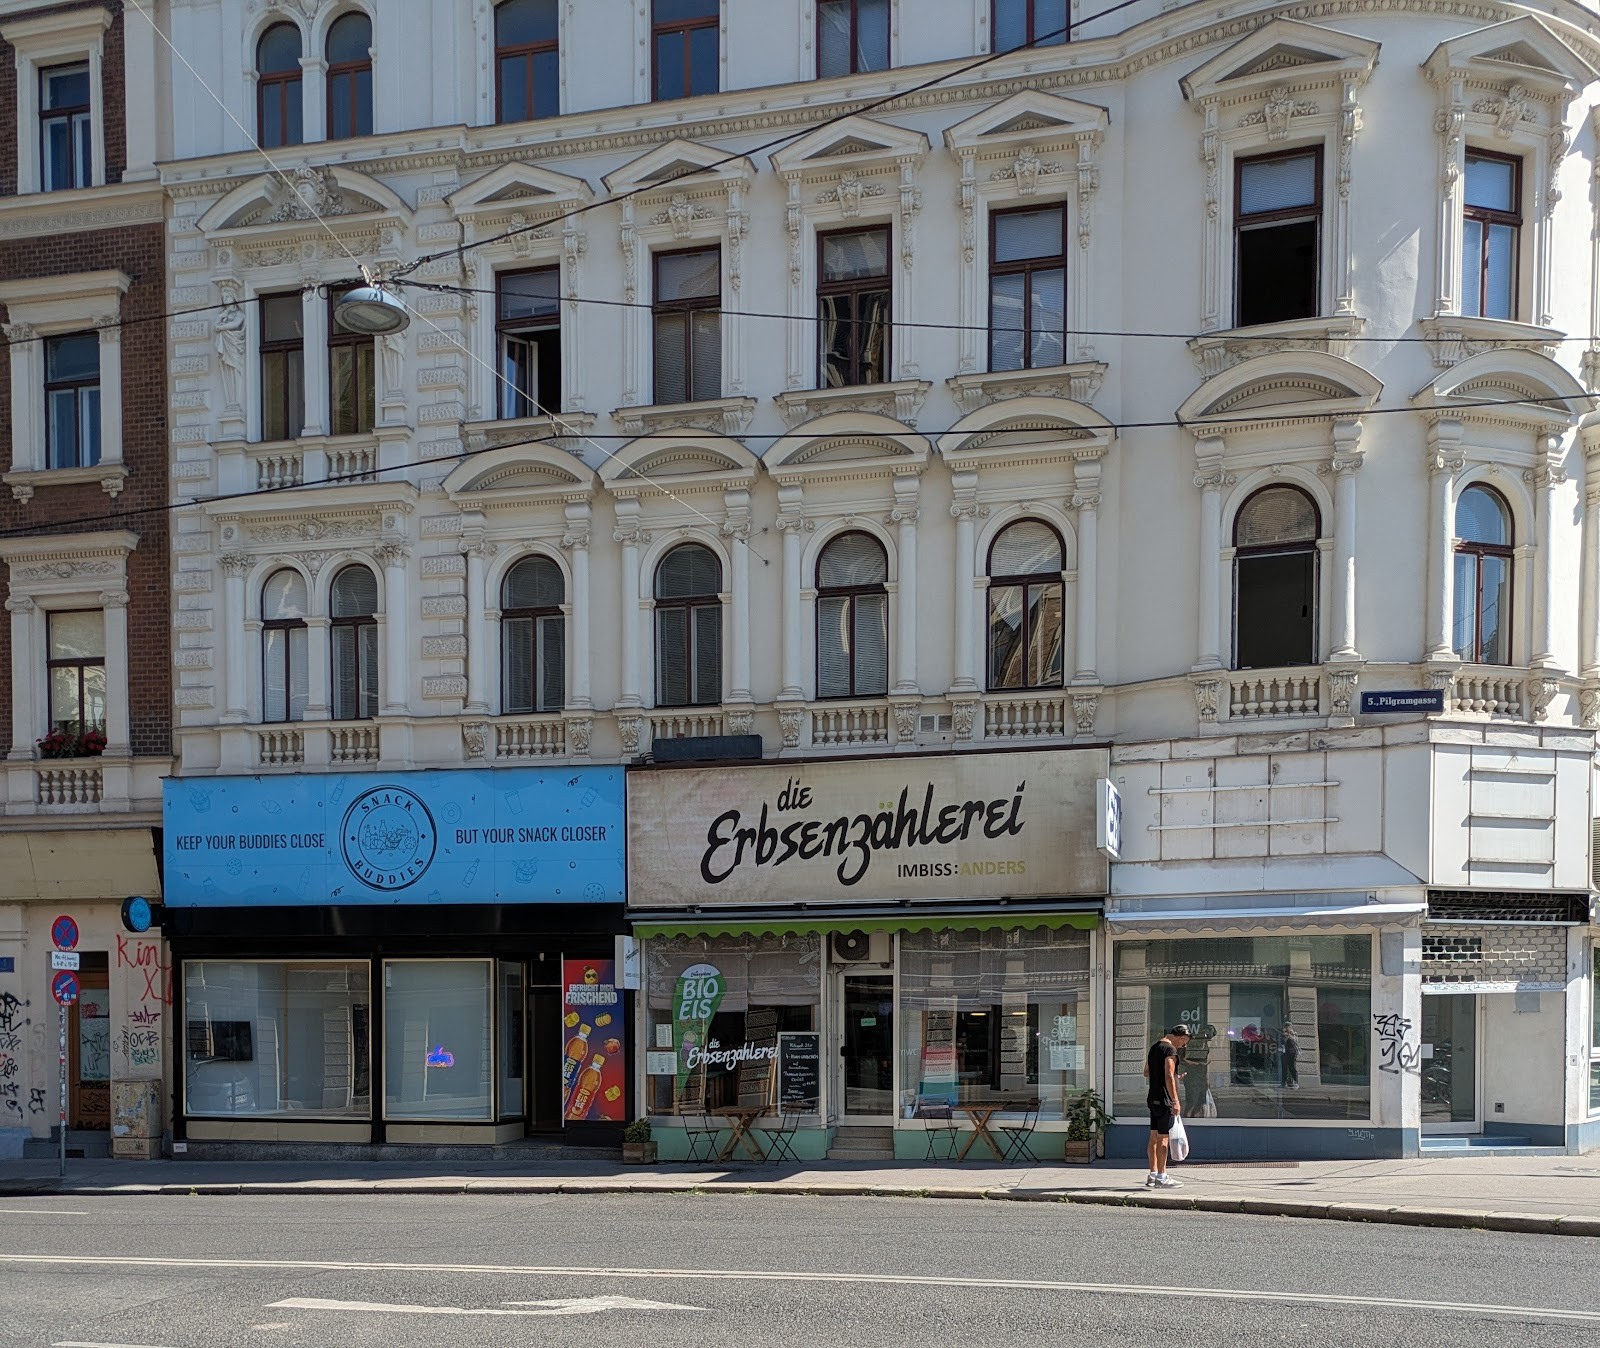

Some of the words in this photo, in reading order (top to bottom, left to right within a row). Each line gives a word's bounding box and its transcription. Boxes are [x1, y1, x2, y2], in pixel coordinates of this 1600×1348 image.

[361, 793, 413, 813] SNACK
[777, 776, 814, 812] die
[176, 835, 202, 850] KEEP
[205, 834, 235, 849] YOUR
[239, 833, 287, 849] BUDDIES
[290, 833, 325, 848] CLOSE
[456, 829, 478, 844] BUT
[482, 828, 514, 844] YOUR
[518, 827, 557, 843] SNACK
[561, 826, 606, 842] CLOSER
[700, 780, 1026, 886] Erbsenzählerei
[354, 857, 424, 884] BUDDIES
[565, 991, 618, 1005] FRISCHEND
[682, 978, 719, 1000] BIO
[678, 999, 712, 1020] EIS
[709, 1038, 721, 1049] die
